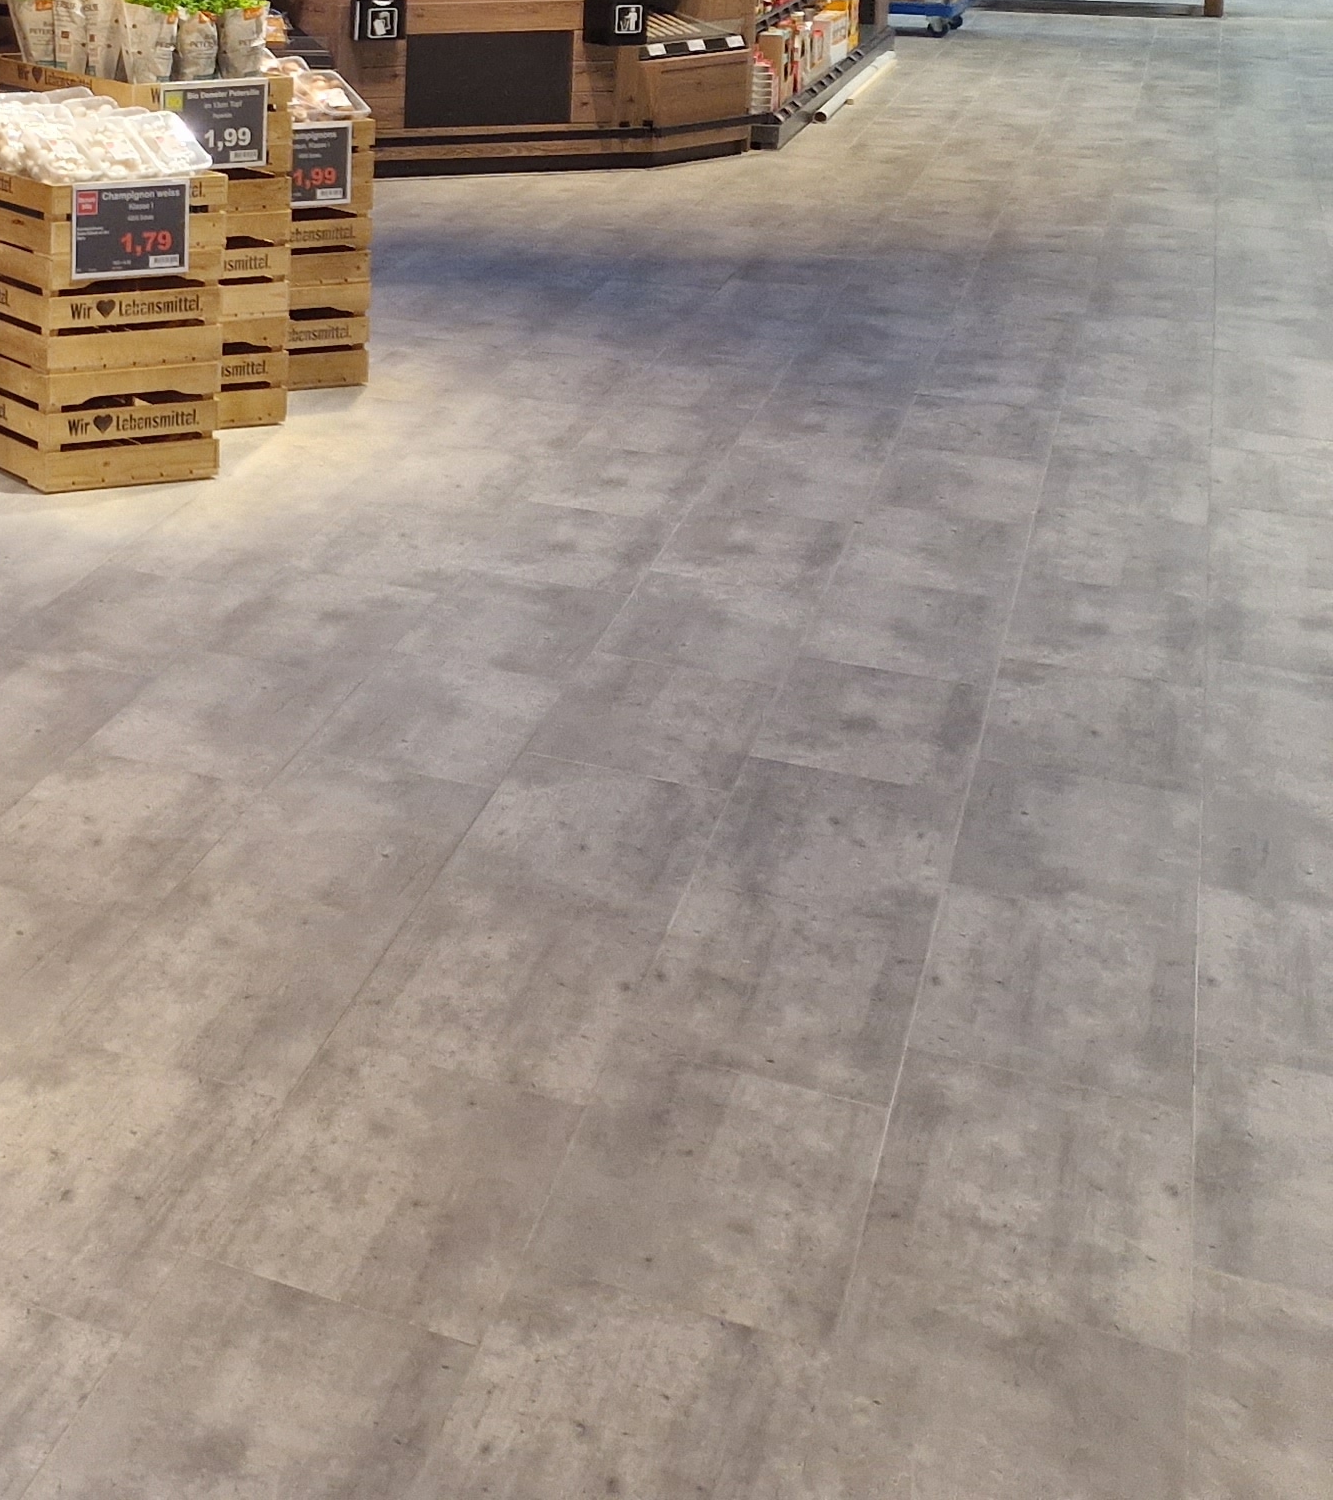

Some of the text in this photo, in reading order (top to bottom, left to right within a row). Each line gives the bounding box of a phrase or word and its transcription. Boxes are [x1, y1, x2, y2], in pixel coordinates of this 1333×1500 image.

[203, 126, 252, 151] 1,99
[291, 166, 338, 190] 1,99
[101, 190, 155, 203] Champignon
[156, 188, 181, 199] weiss
[120, 229, 173, 257] 1,79
[289, 223, 356, 243] ebensmittel.
[223, 252, 272, 273] smittel.
[70, 294, 204, 321] Wir Lebensmittel.
[221, 359, 270, 379] smittel.
[68, 408, 200, 437] Wir Lebensmittel.
